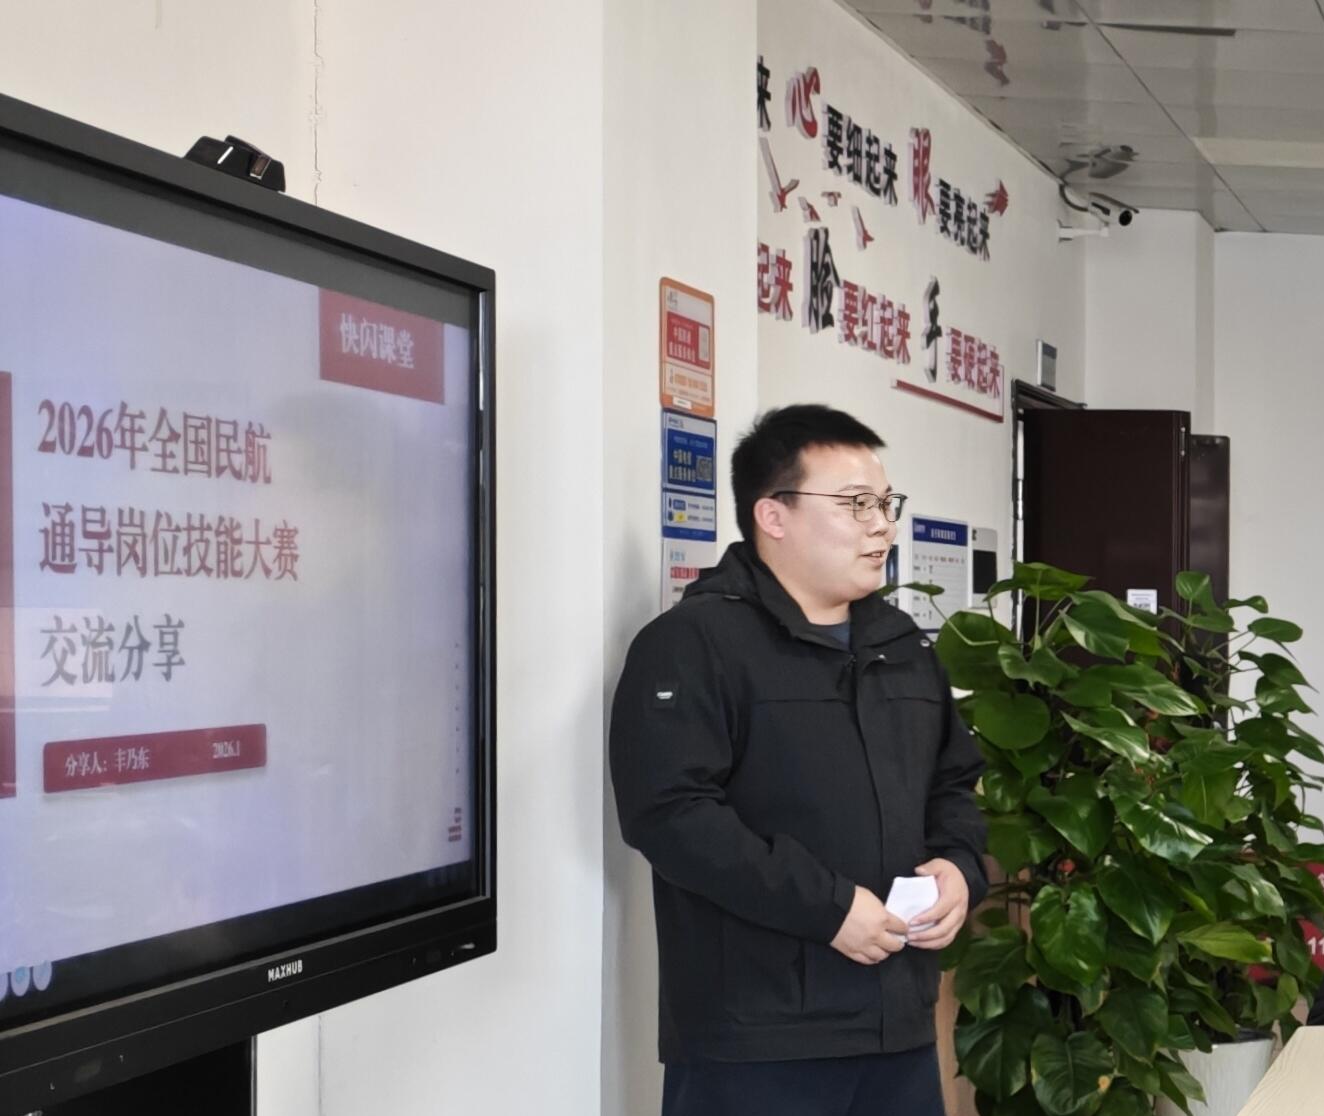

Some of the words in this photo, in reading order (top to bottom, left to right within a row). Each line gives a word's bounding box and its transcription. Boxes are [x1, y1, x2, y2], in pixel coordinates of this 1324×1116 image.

[340, 313, 414, 369] 快闪课堂
[38, 399, 272, 484] 2026年全国民航
[39, 502, 300, 581] 通导岗位技能大赛
[40, 613, 185, 686] 交流分享
[268, 960, 303, 982] MAXHUB
